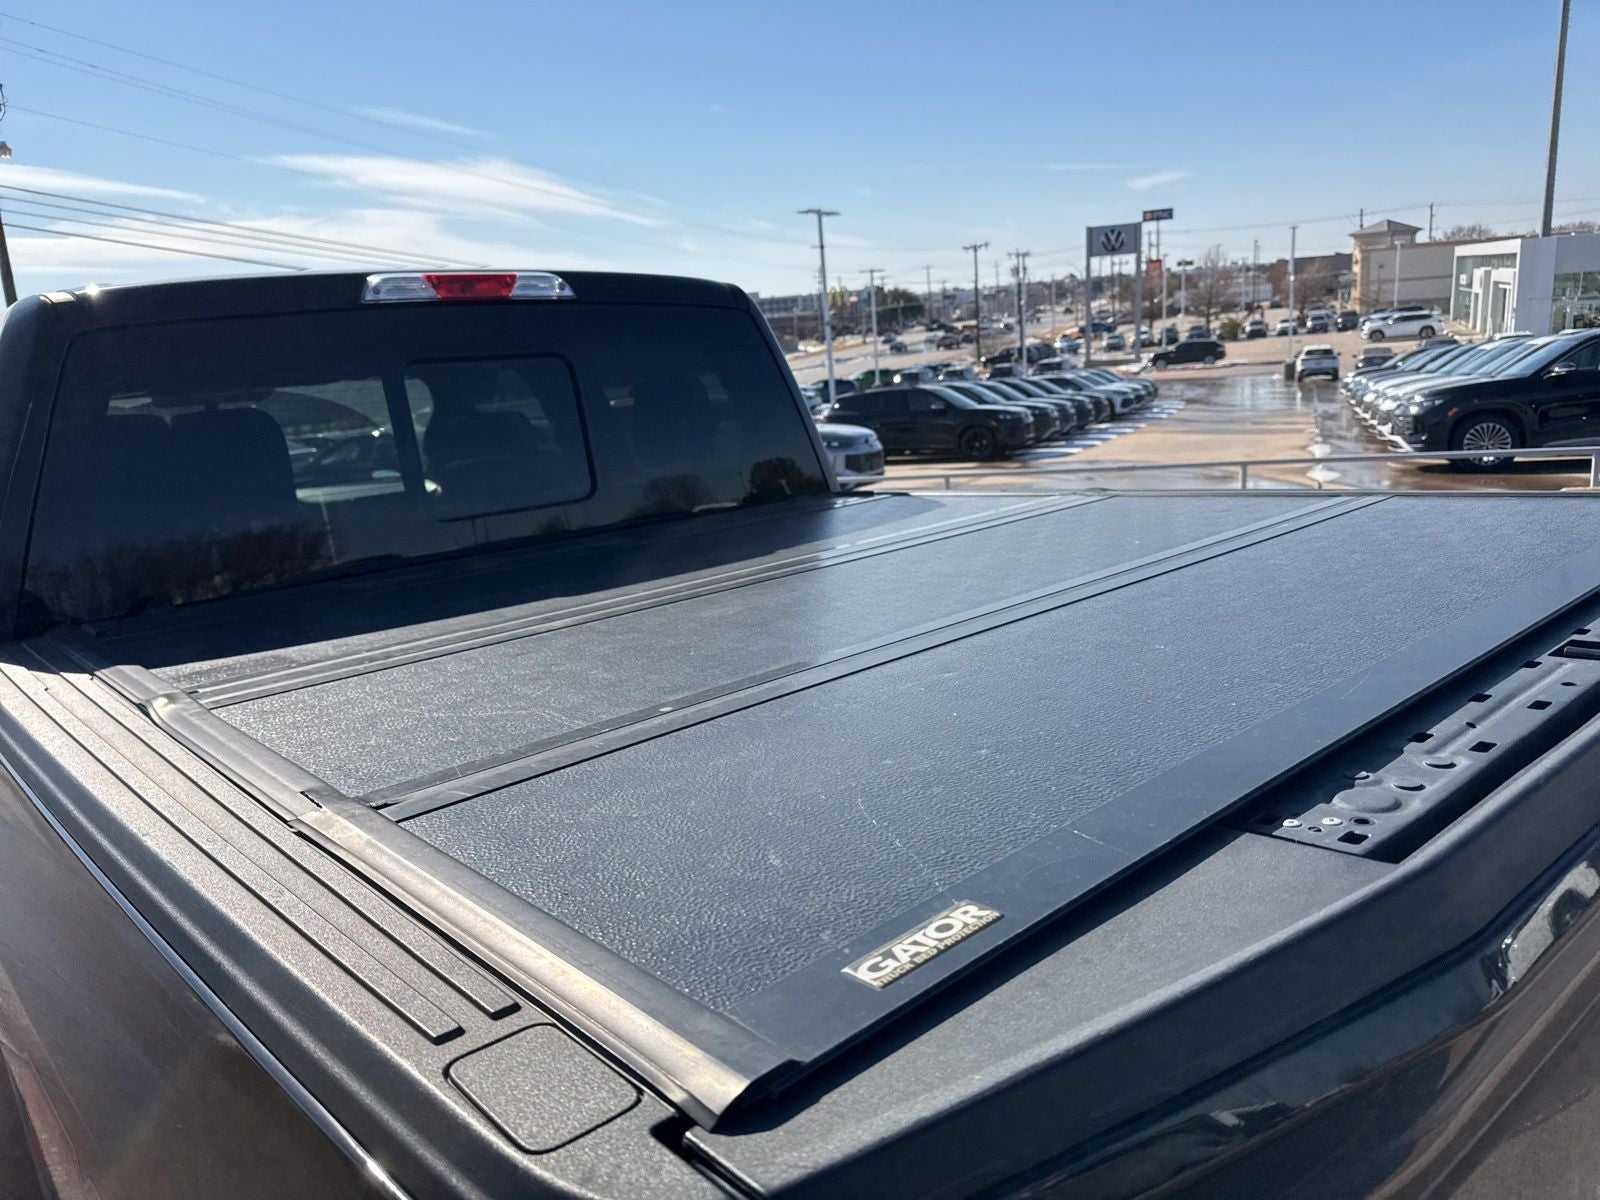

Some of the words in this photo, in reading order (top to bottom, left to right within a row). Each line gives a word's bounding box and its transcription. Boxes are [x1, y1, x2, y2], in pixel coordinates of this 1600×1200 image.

[857, 904, 991, 980] GATOR
[877, 962, 913, 986] TRUCK
[914, 946, 938, 964] BED
[938, 911, 999, 950] PROTECTION
